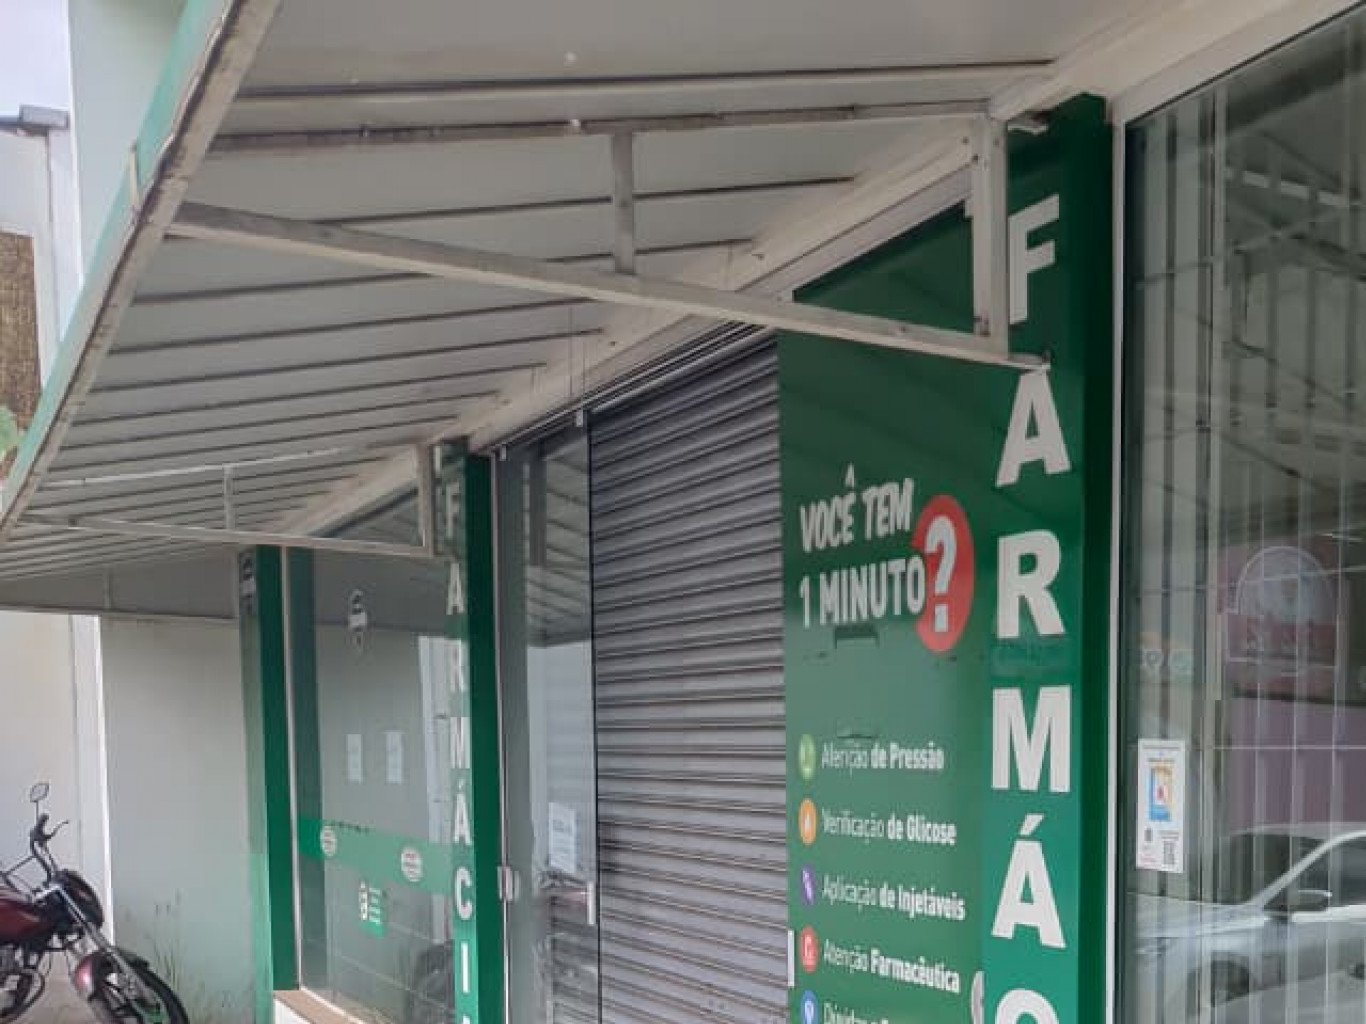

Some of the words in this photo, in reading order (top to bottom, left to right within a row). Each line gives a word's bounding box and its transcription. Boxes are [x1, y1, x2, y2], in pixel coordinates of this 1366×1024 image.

[800, 463, 856, 553] VOCÊ
[862, 477, 914, 541] TEM
[800, 575, 811, 628] 1
[870, 742, 887, 769] de
[887, 812, 905, 840] de
[879, 881, 896, 908] de
